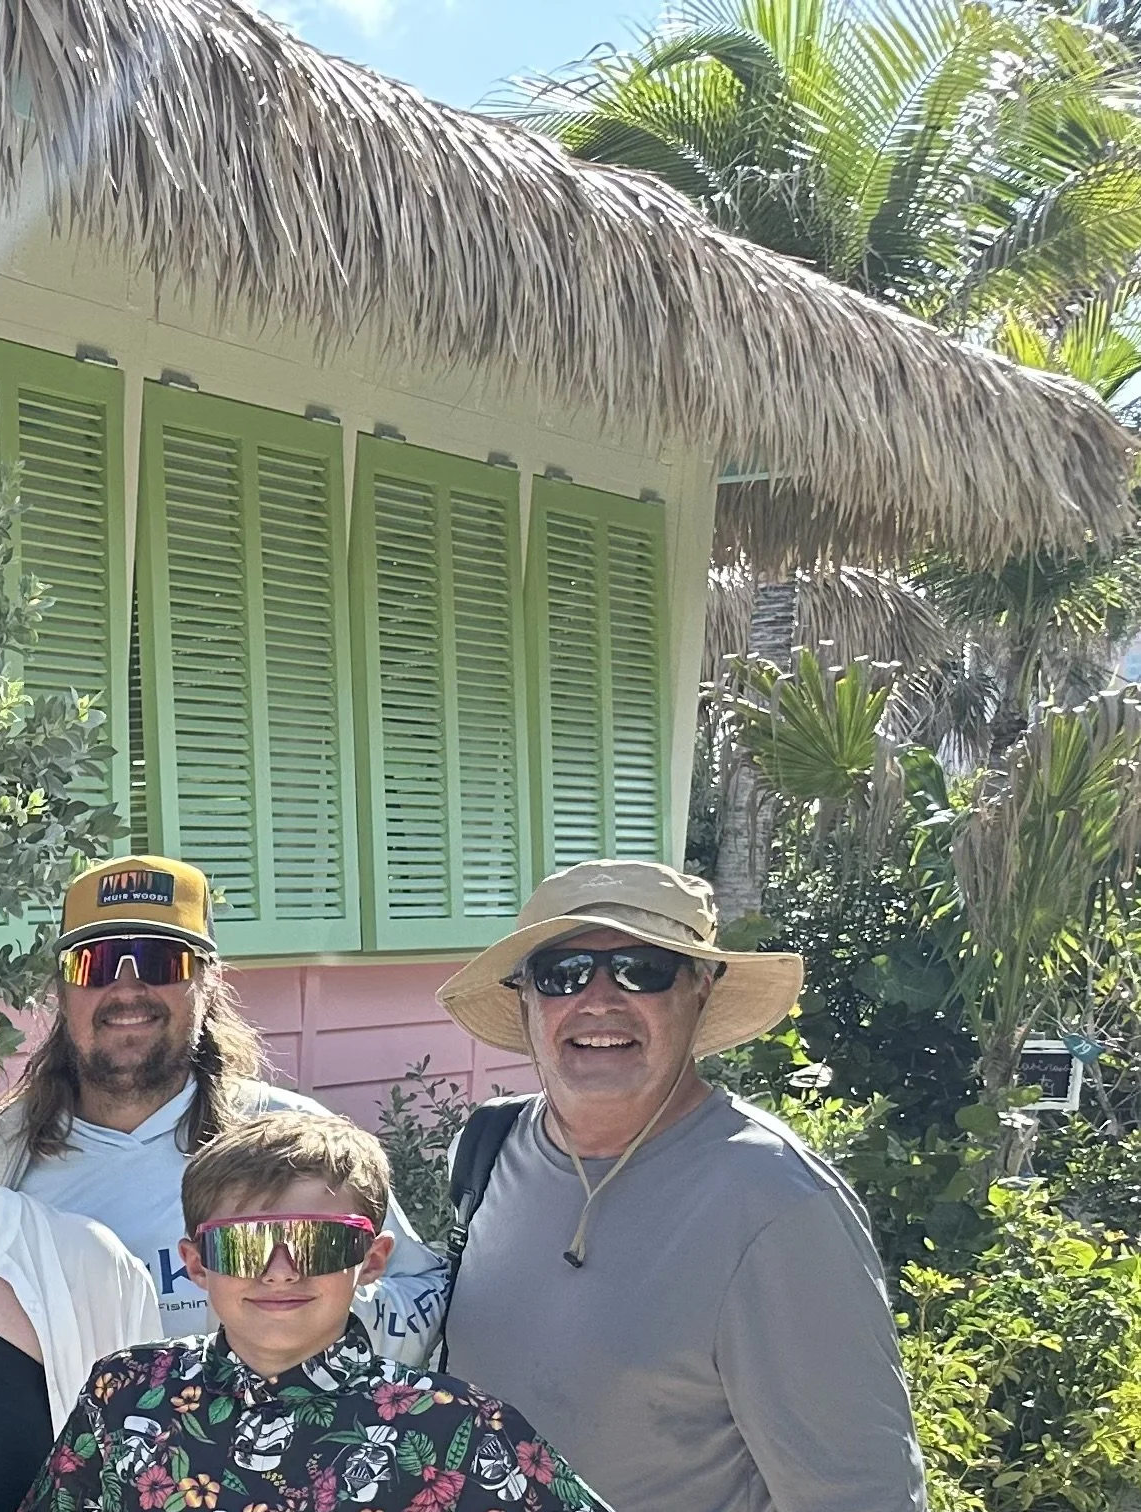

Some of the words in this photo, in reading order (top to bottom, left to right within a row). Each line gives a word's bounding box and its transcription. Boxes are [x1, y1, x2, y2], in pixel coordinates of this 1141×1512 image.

[103, 893, 128, 902] MUIR
[132, 892, 169, 902] WOODS
[1073, 1040, 1092, 1055] 29
[1016, 1072, 1055, 1096] Pty
